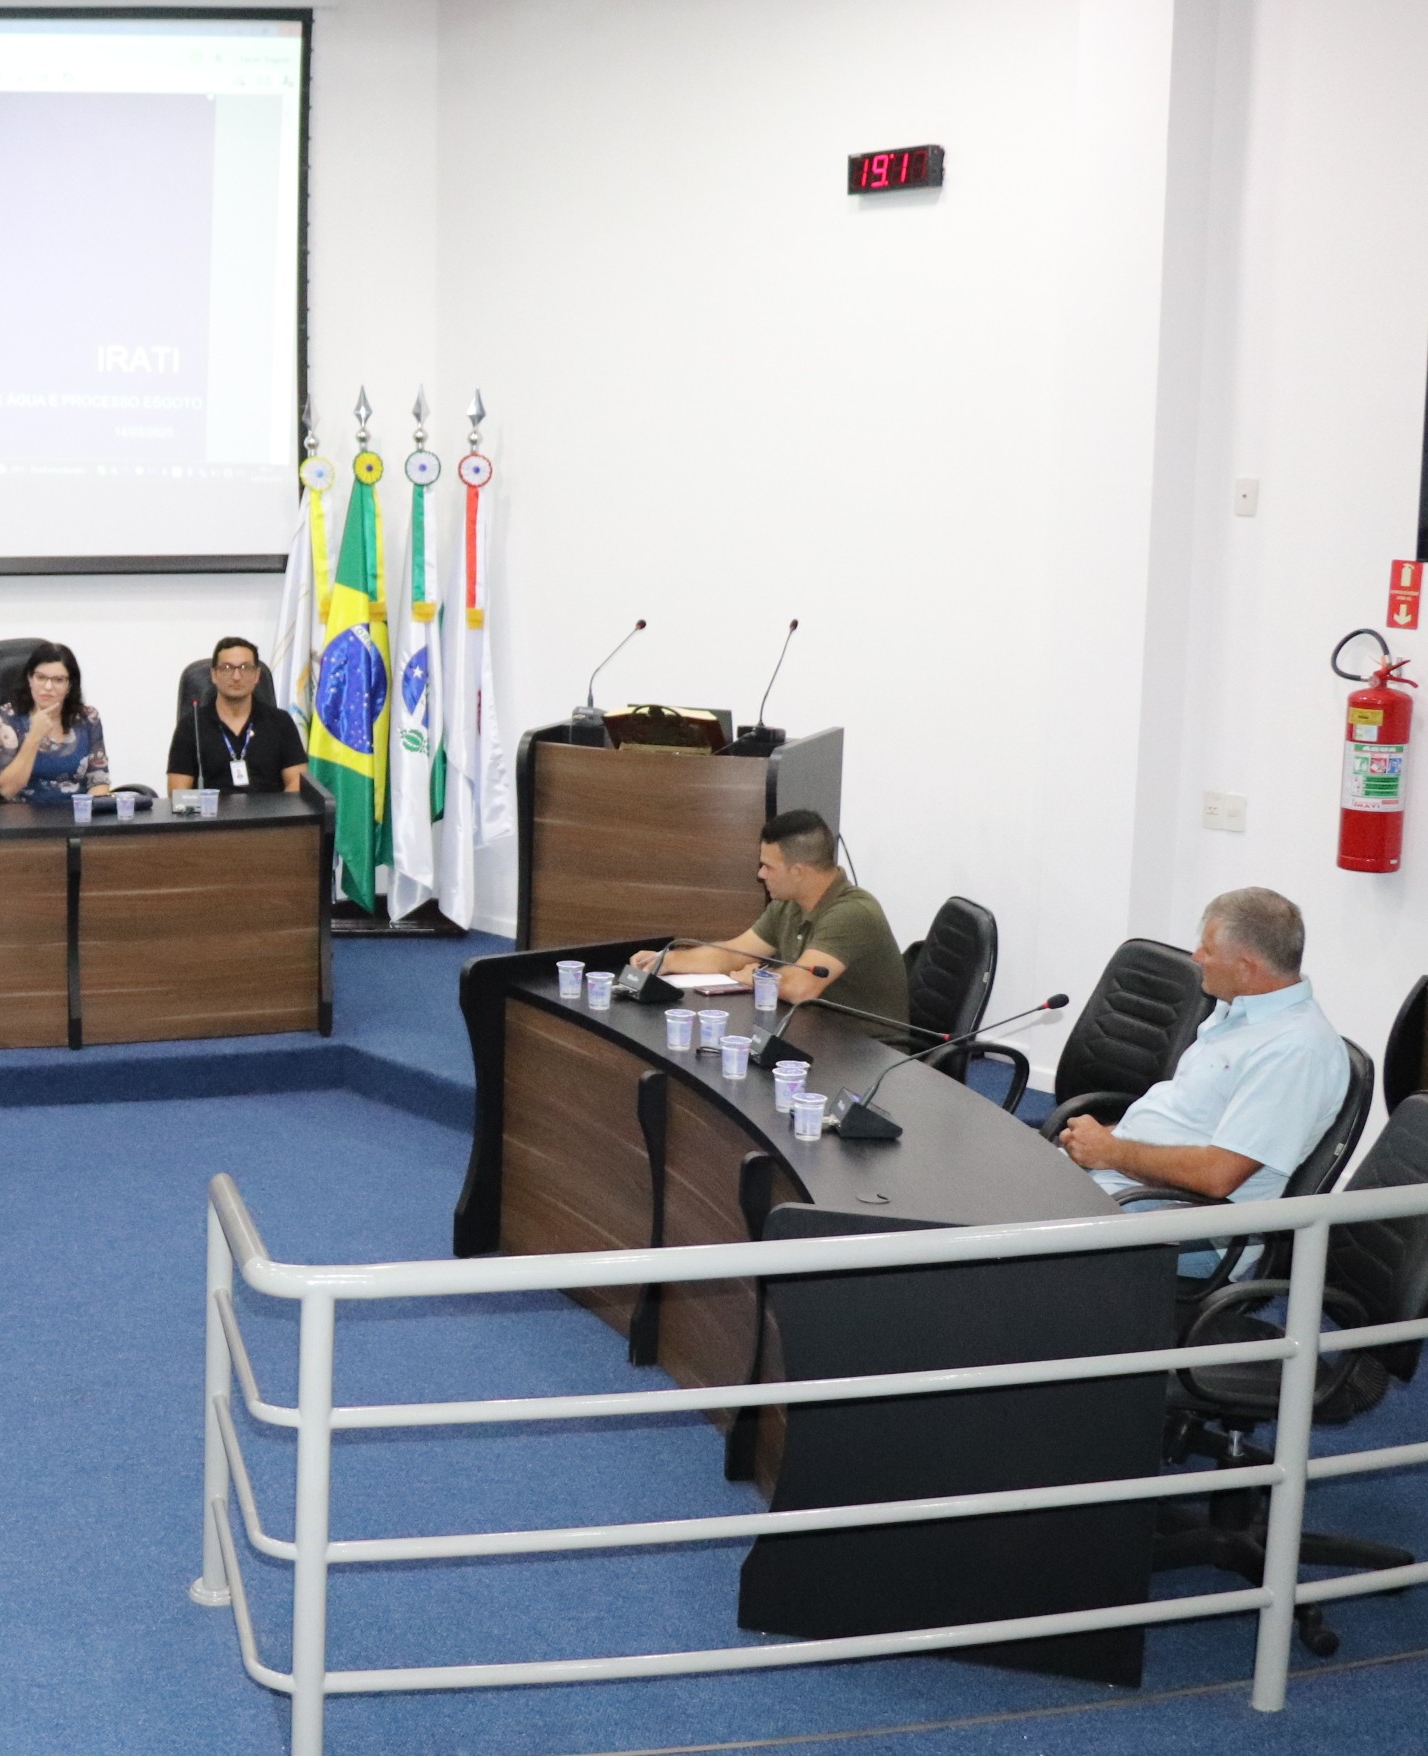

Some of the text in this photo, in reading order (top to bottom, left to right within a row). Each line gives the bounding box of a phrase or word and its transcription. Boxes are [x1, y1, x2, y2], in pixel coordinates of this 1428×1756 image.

[97, 344, 180, 374] IRATI
[49, 393, 59, 408] E
[61, 393, 139, 409] PROCESSO
[143, 394, 202, 410] ESGOTO
